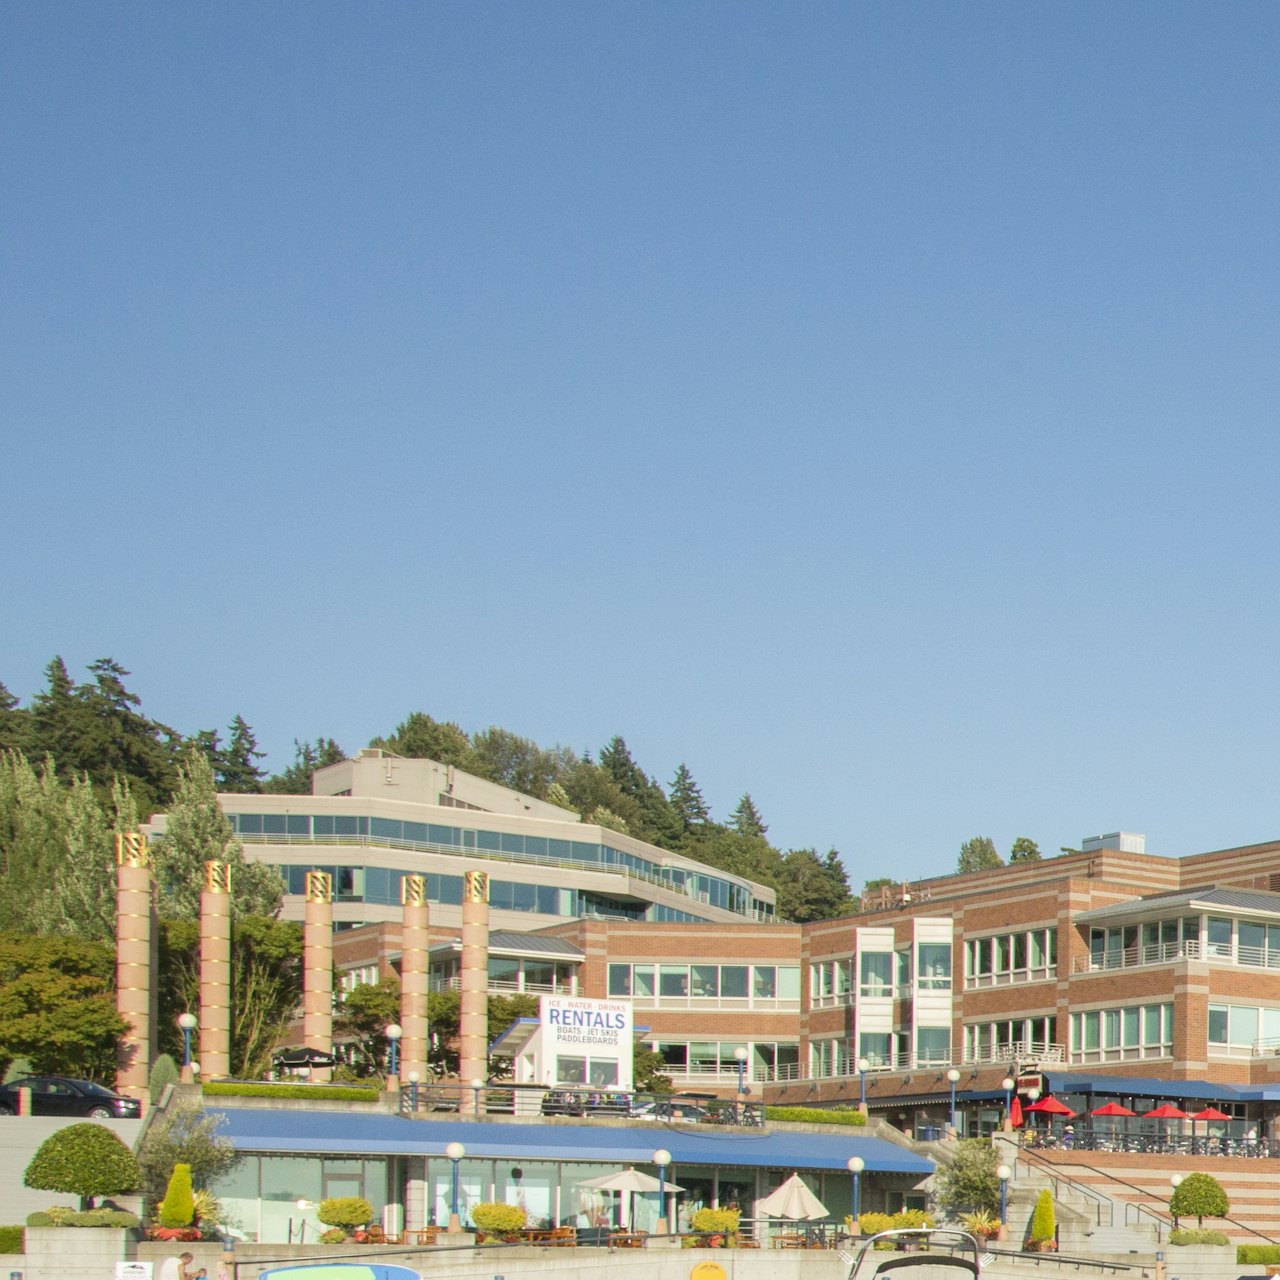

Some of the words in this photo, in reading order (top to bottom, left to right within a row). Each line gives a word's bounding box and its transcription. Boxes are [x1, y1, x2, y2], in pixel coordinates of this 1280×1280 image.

[568, 1001, 592, 1009] WATER
[598, 1003, 626, 1012] DRINKS
[549, 1008, 625, 1029] RENTALS
[557, 1026, 582, 1035] BOATS
[587, 1028, 599, 1036] JET
[601, 1029, 619, 1037] SKIS
[556, 1034, 619, 1045] PADDLEBOARDS
